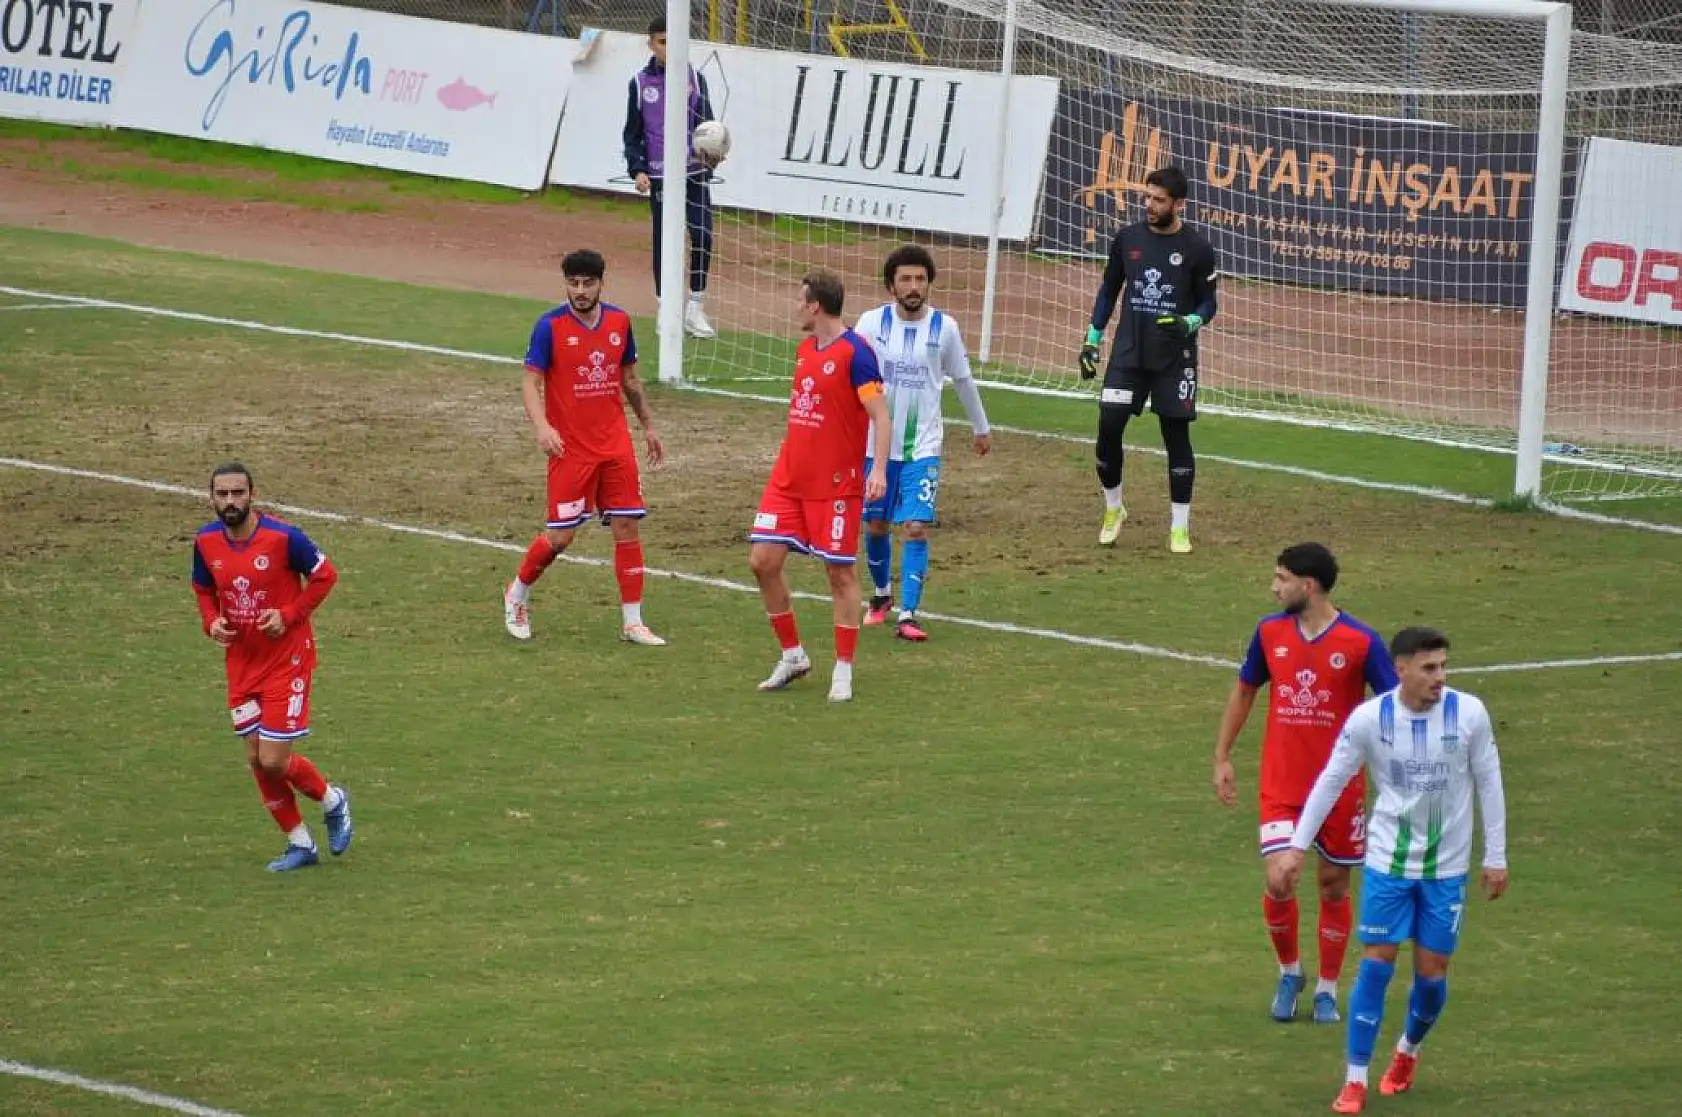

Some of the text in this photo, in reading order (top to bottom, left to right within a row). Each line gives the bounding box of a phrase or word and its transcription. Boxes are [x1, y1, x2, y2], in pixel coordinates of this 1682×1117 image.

[57, 69, 112, 104] DİLER
[380, 67, 428, 105] PORT
[781, 66, 966, 179] LLULL
[1206, 141, 1534, 222] UYAR İNŞAAT
[1179, 380, 1197, 399] 97
[1449, 903, 1463, 934] 7
